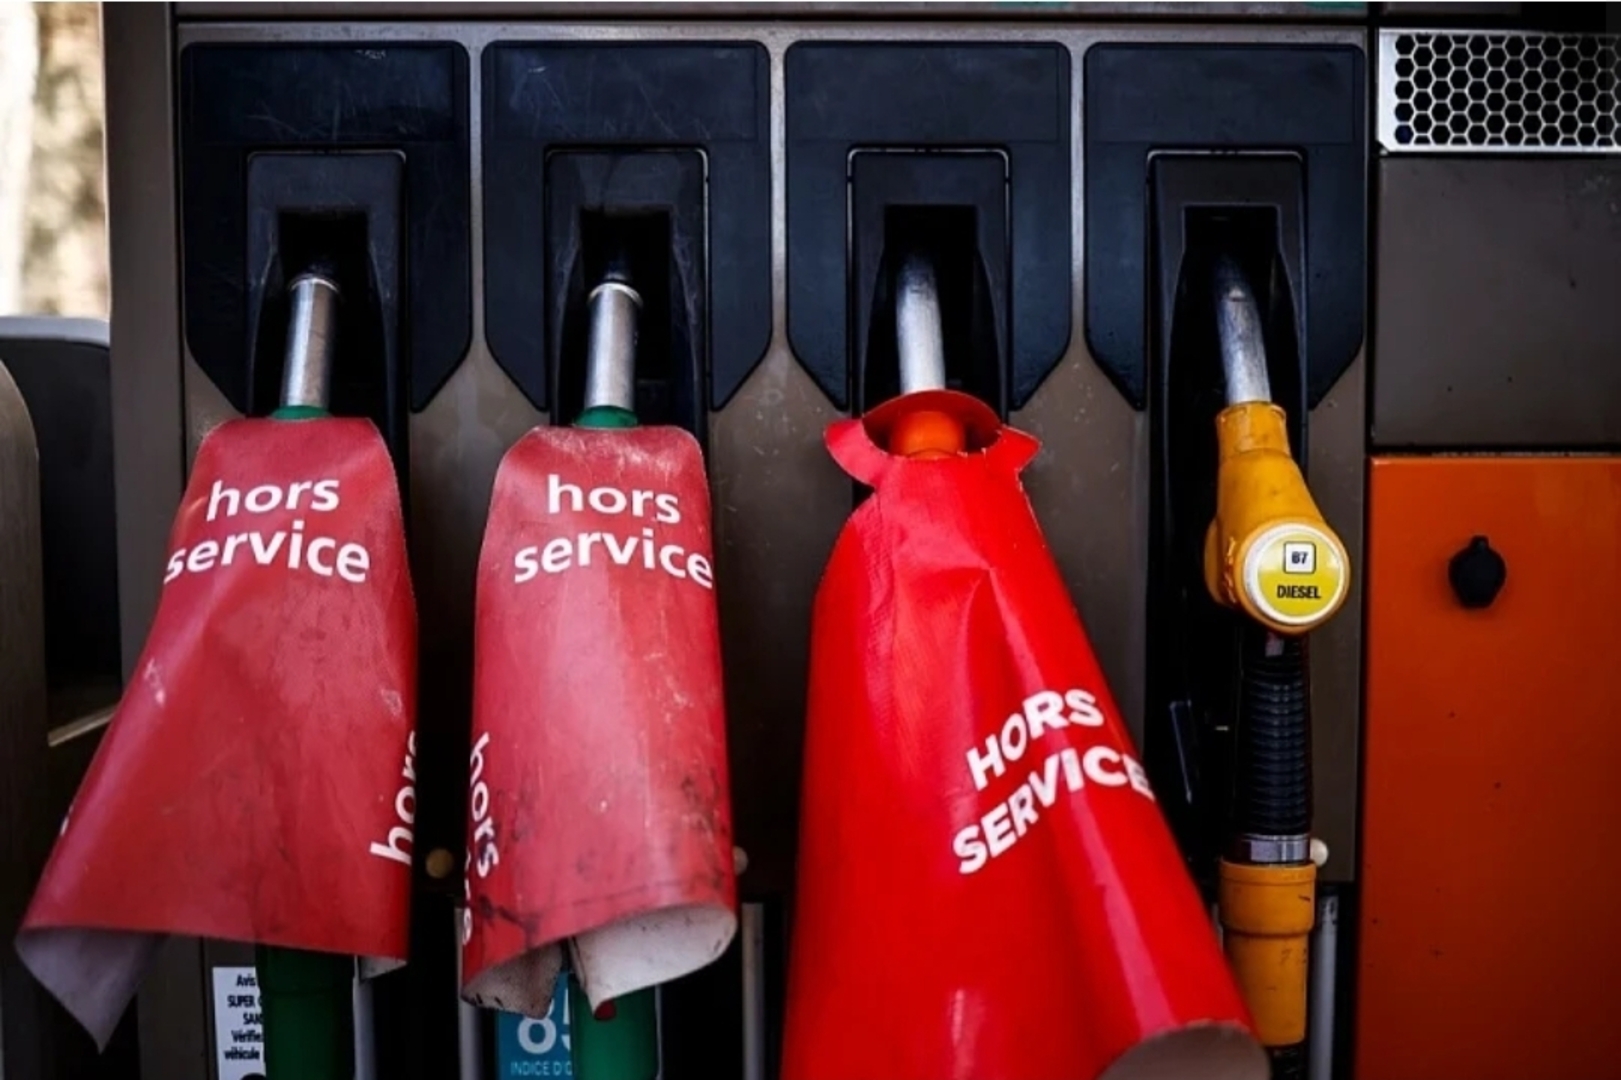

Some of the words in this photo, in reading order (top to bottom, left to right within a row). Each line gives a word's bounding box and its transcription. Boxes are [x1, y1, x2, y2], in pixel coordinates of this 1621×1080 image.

[206, 479, 340, 522] hors
[548, 474, 681, 524] hors
[163, 519, 370, 584] service
[514, 527, 713, 590] service
[1276, 585, 1321, 599] DIESEL
[966, 689, 1104, 791] HORS
[953, 745, 1155, 874] SERVICE
[227, 995, 256, 1008] SUPER
[236, 974, 256, 987] Avis
[510, 1061, 551, 1077] INDICE
